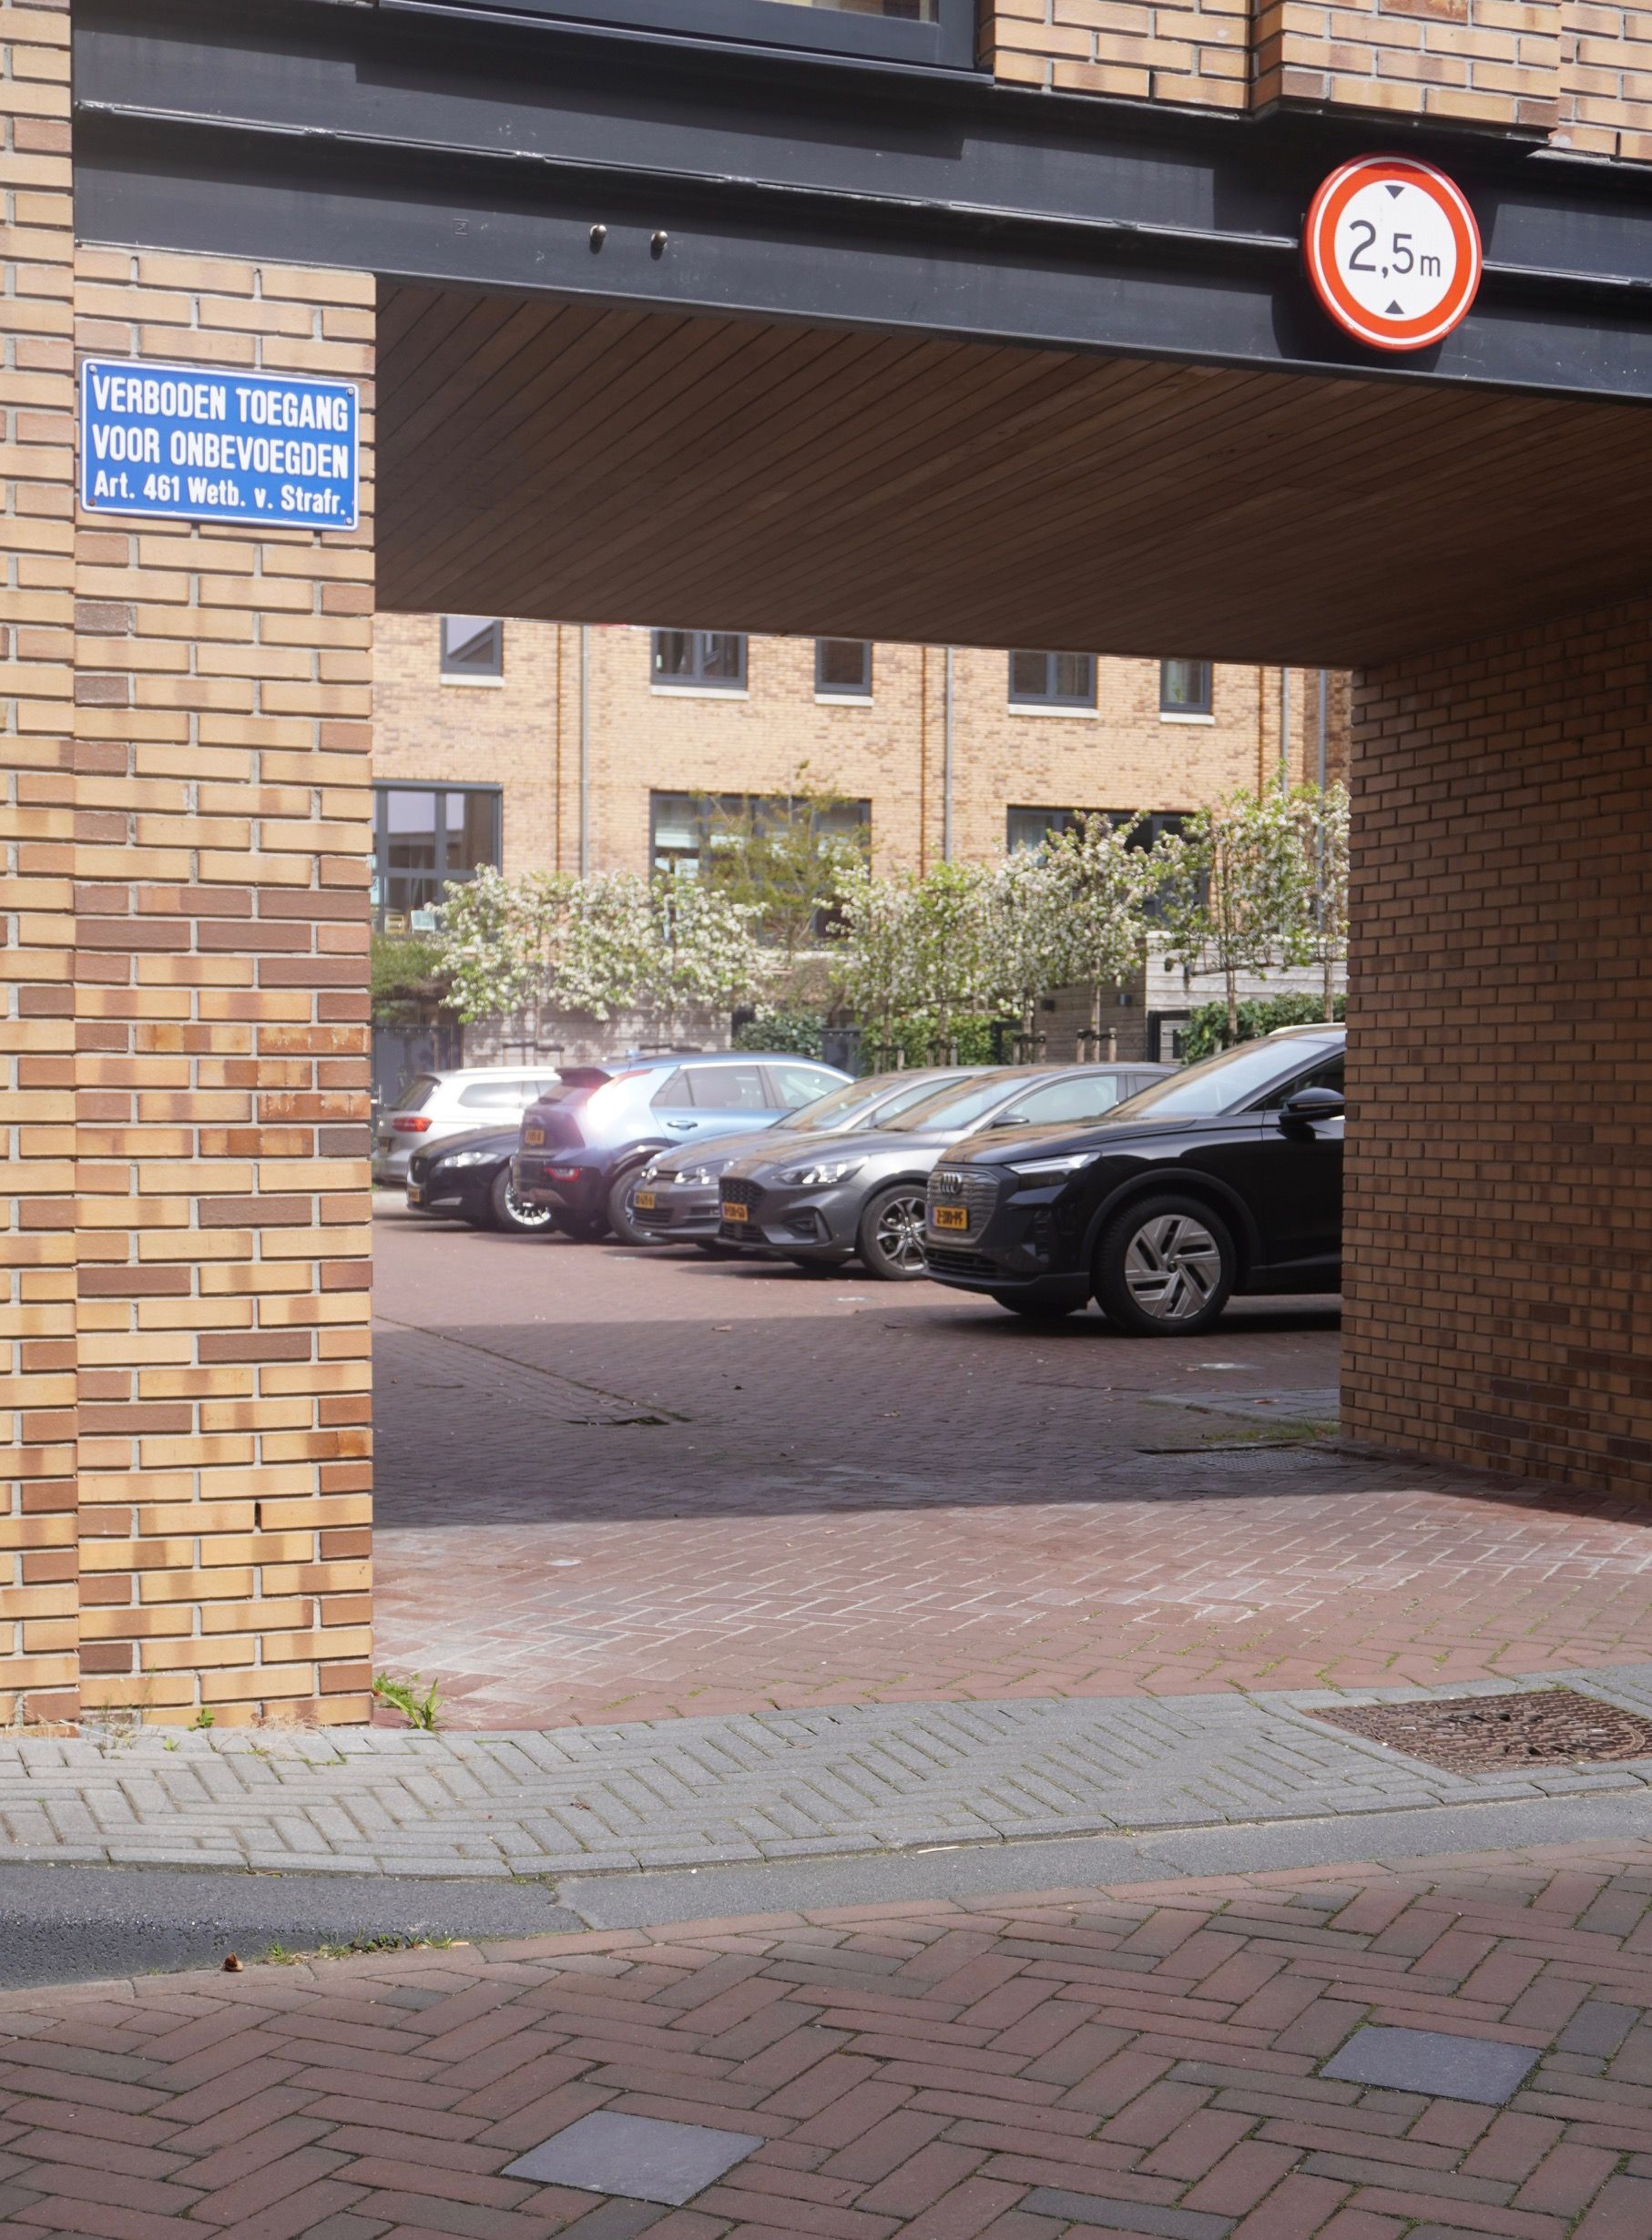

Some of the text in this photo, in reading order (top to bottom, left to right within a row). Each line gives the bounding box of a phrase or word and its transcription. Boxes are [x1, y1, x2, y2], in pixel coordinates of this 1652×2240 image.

[93, 375, 348, 432] VERBODEN TOEGANG
[92, 423, 348, 479] VOOR ONBEVOEGDEN
[94, 470, 346, 515] Art. 461 Wetb. v. Strafr.
